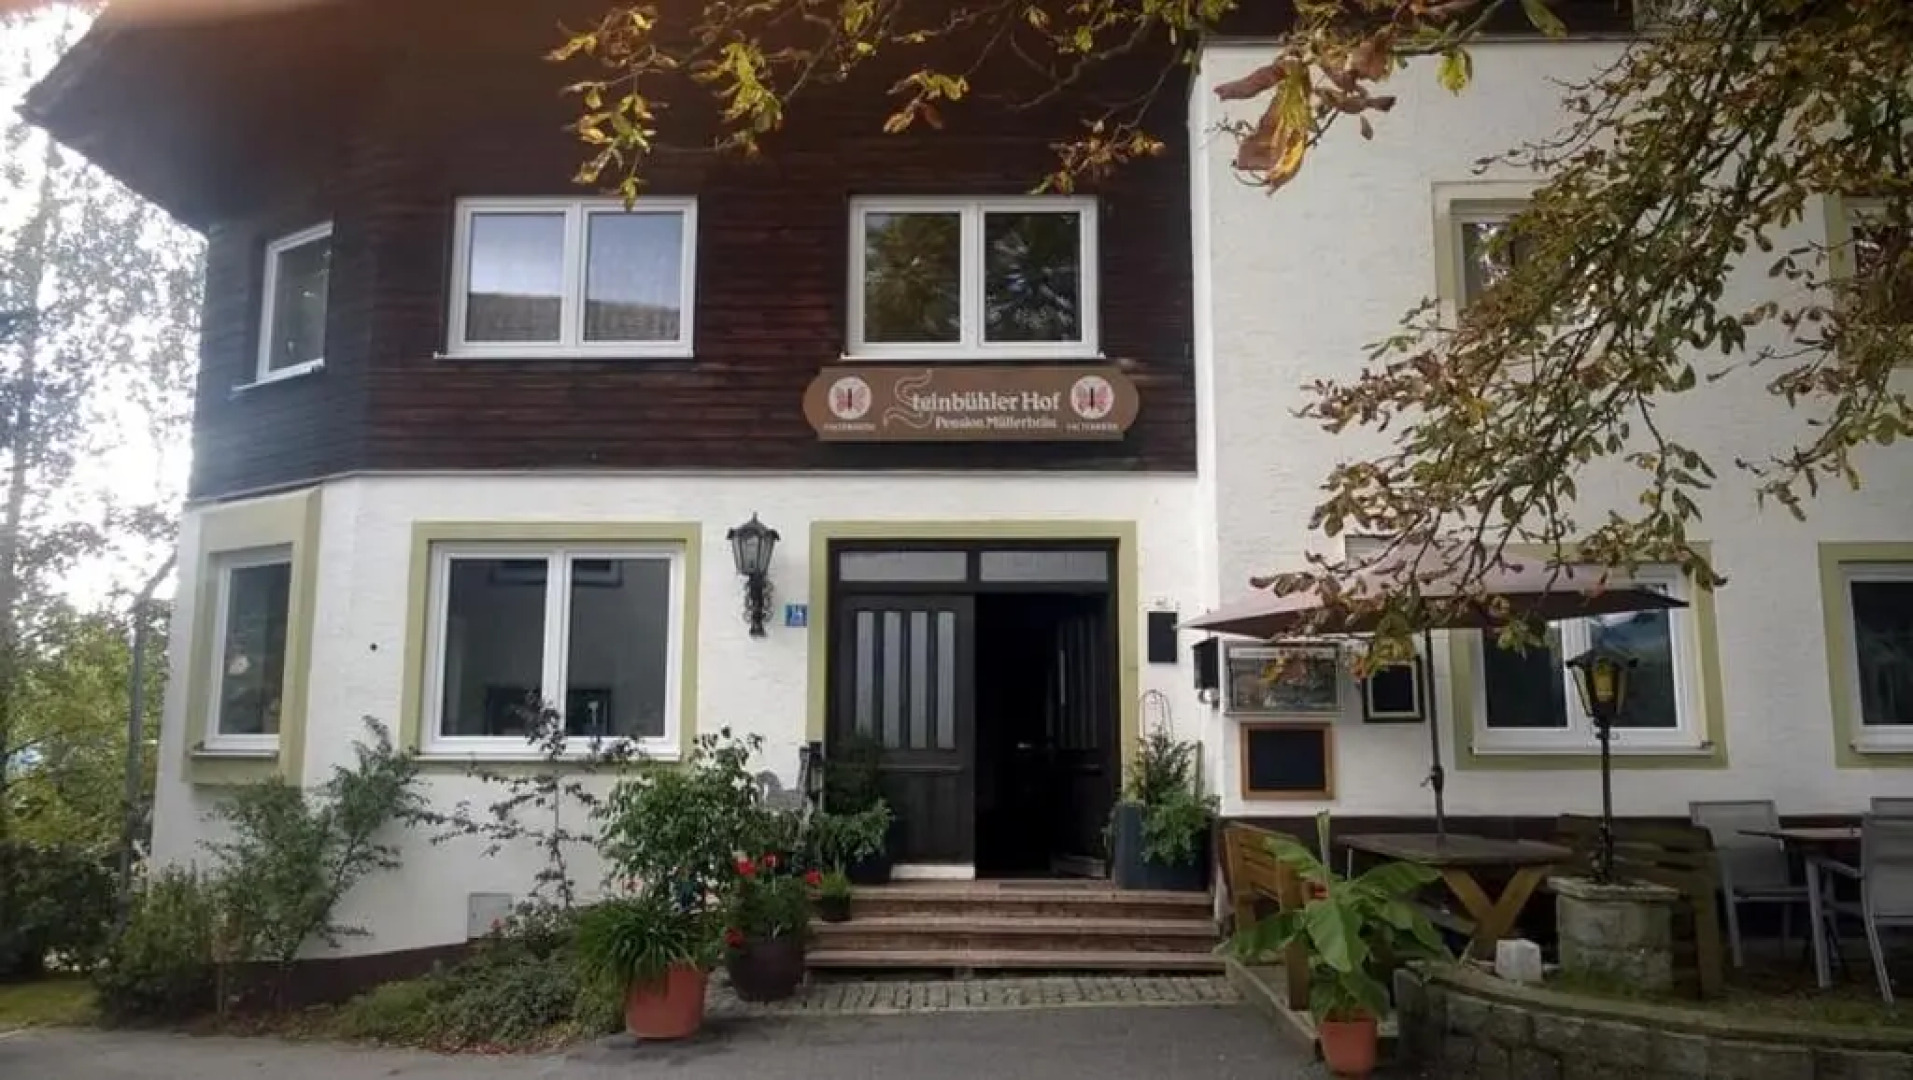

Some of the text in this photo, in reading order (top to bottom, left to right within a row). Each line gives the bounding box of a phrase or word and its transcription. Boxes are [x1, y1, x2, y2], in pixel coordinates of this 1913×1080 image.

[883, 369, 1061, 428] Steinbühler Hof
[935, 416, 984, 430] Pension
